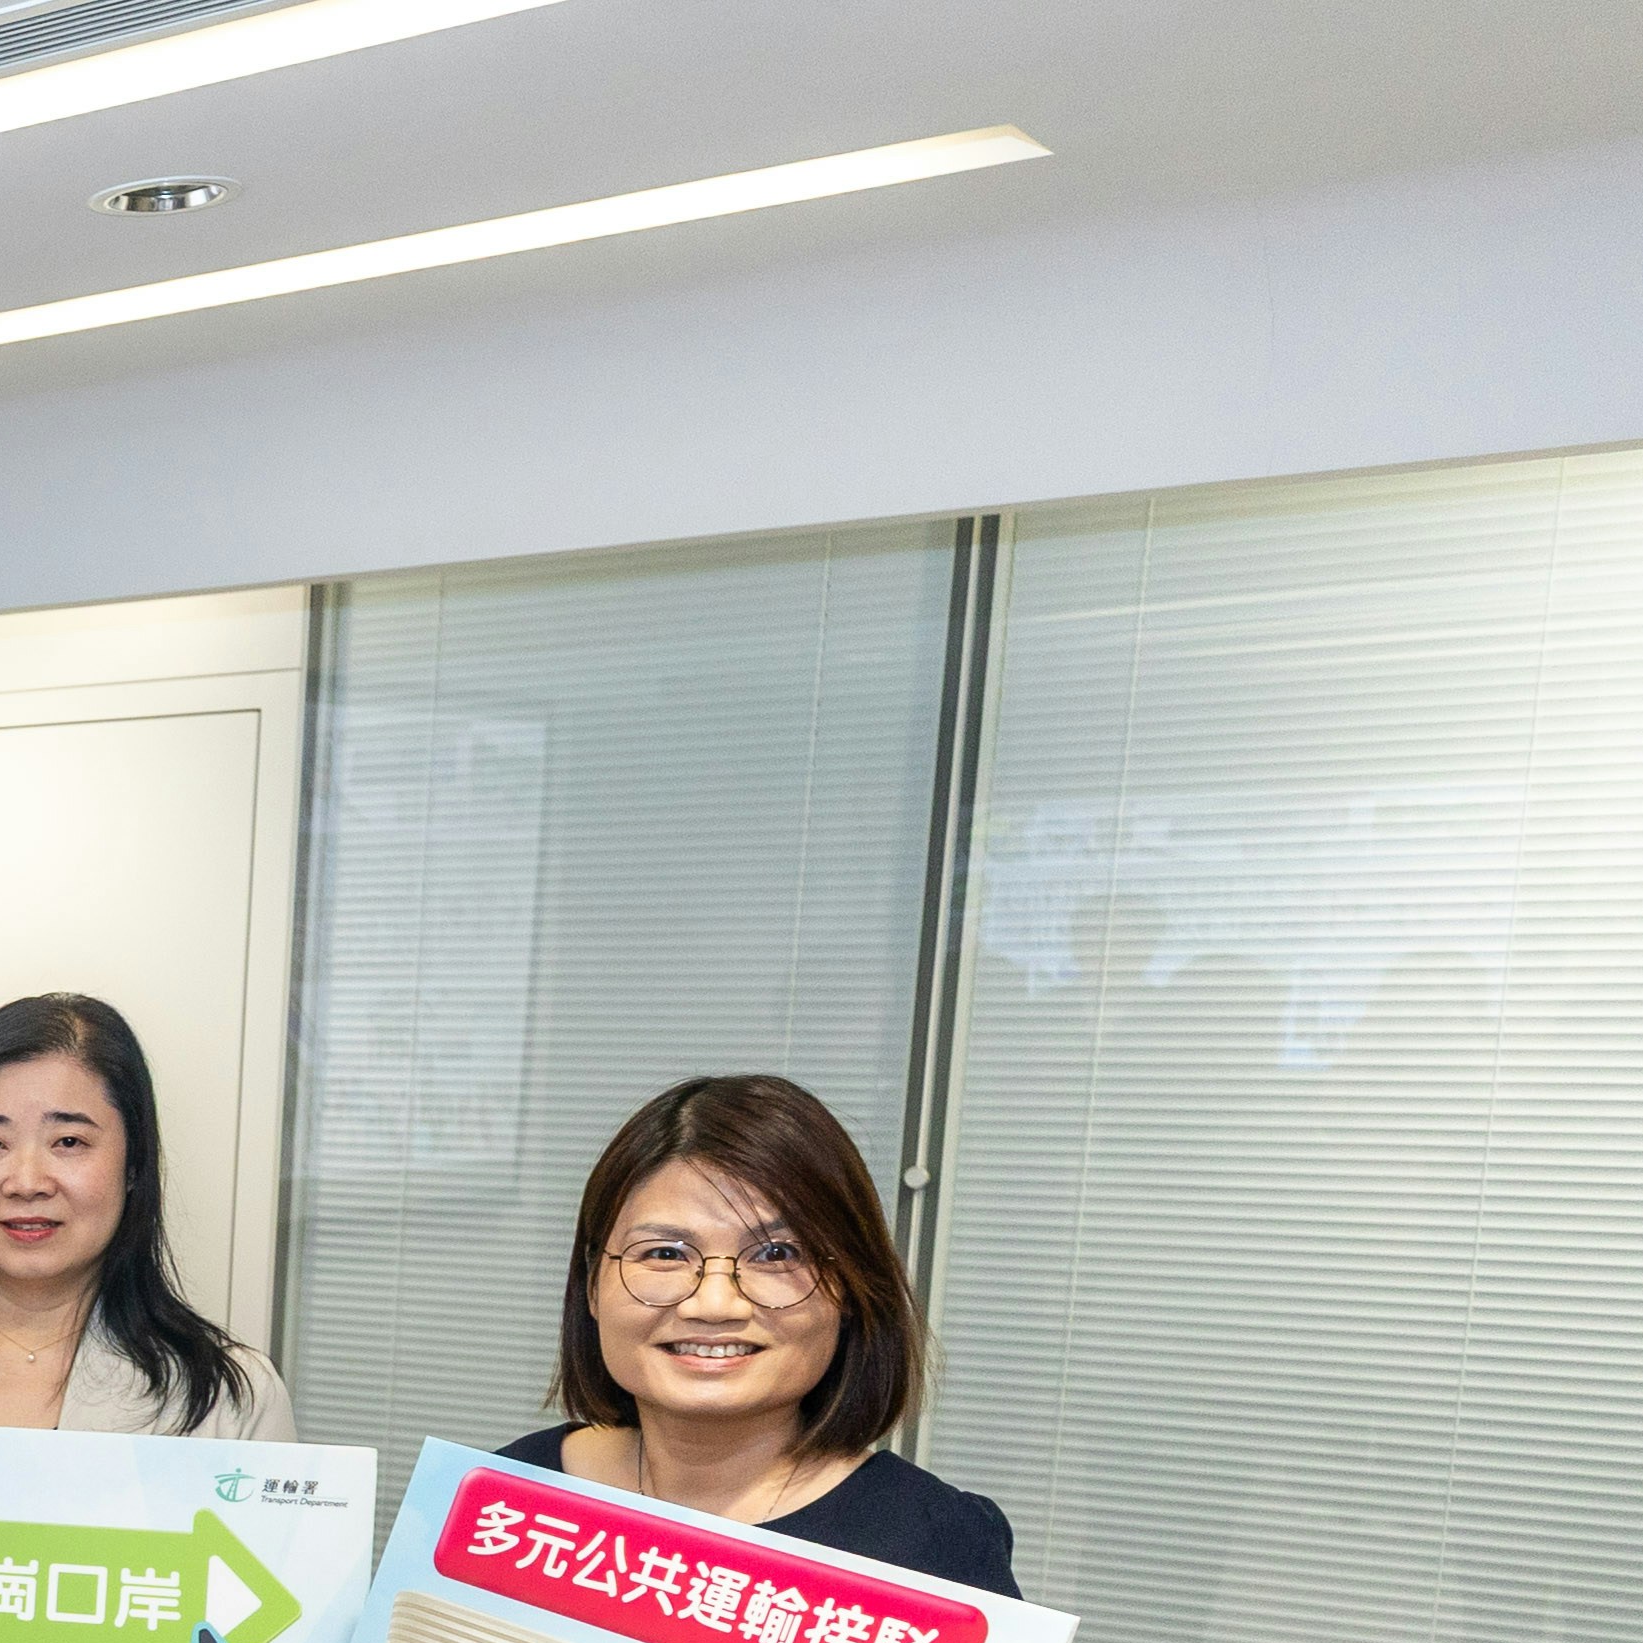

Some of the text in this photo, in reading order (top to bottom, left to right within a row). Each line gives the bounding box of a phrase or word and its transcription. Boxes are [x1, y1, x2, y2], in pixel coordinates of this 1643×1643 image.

[262, 1478, 319, 1495] 運輸署
[261, 1495, 349, 1508] Transport Department
